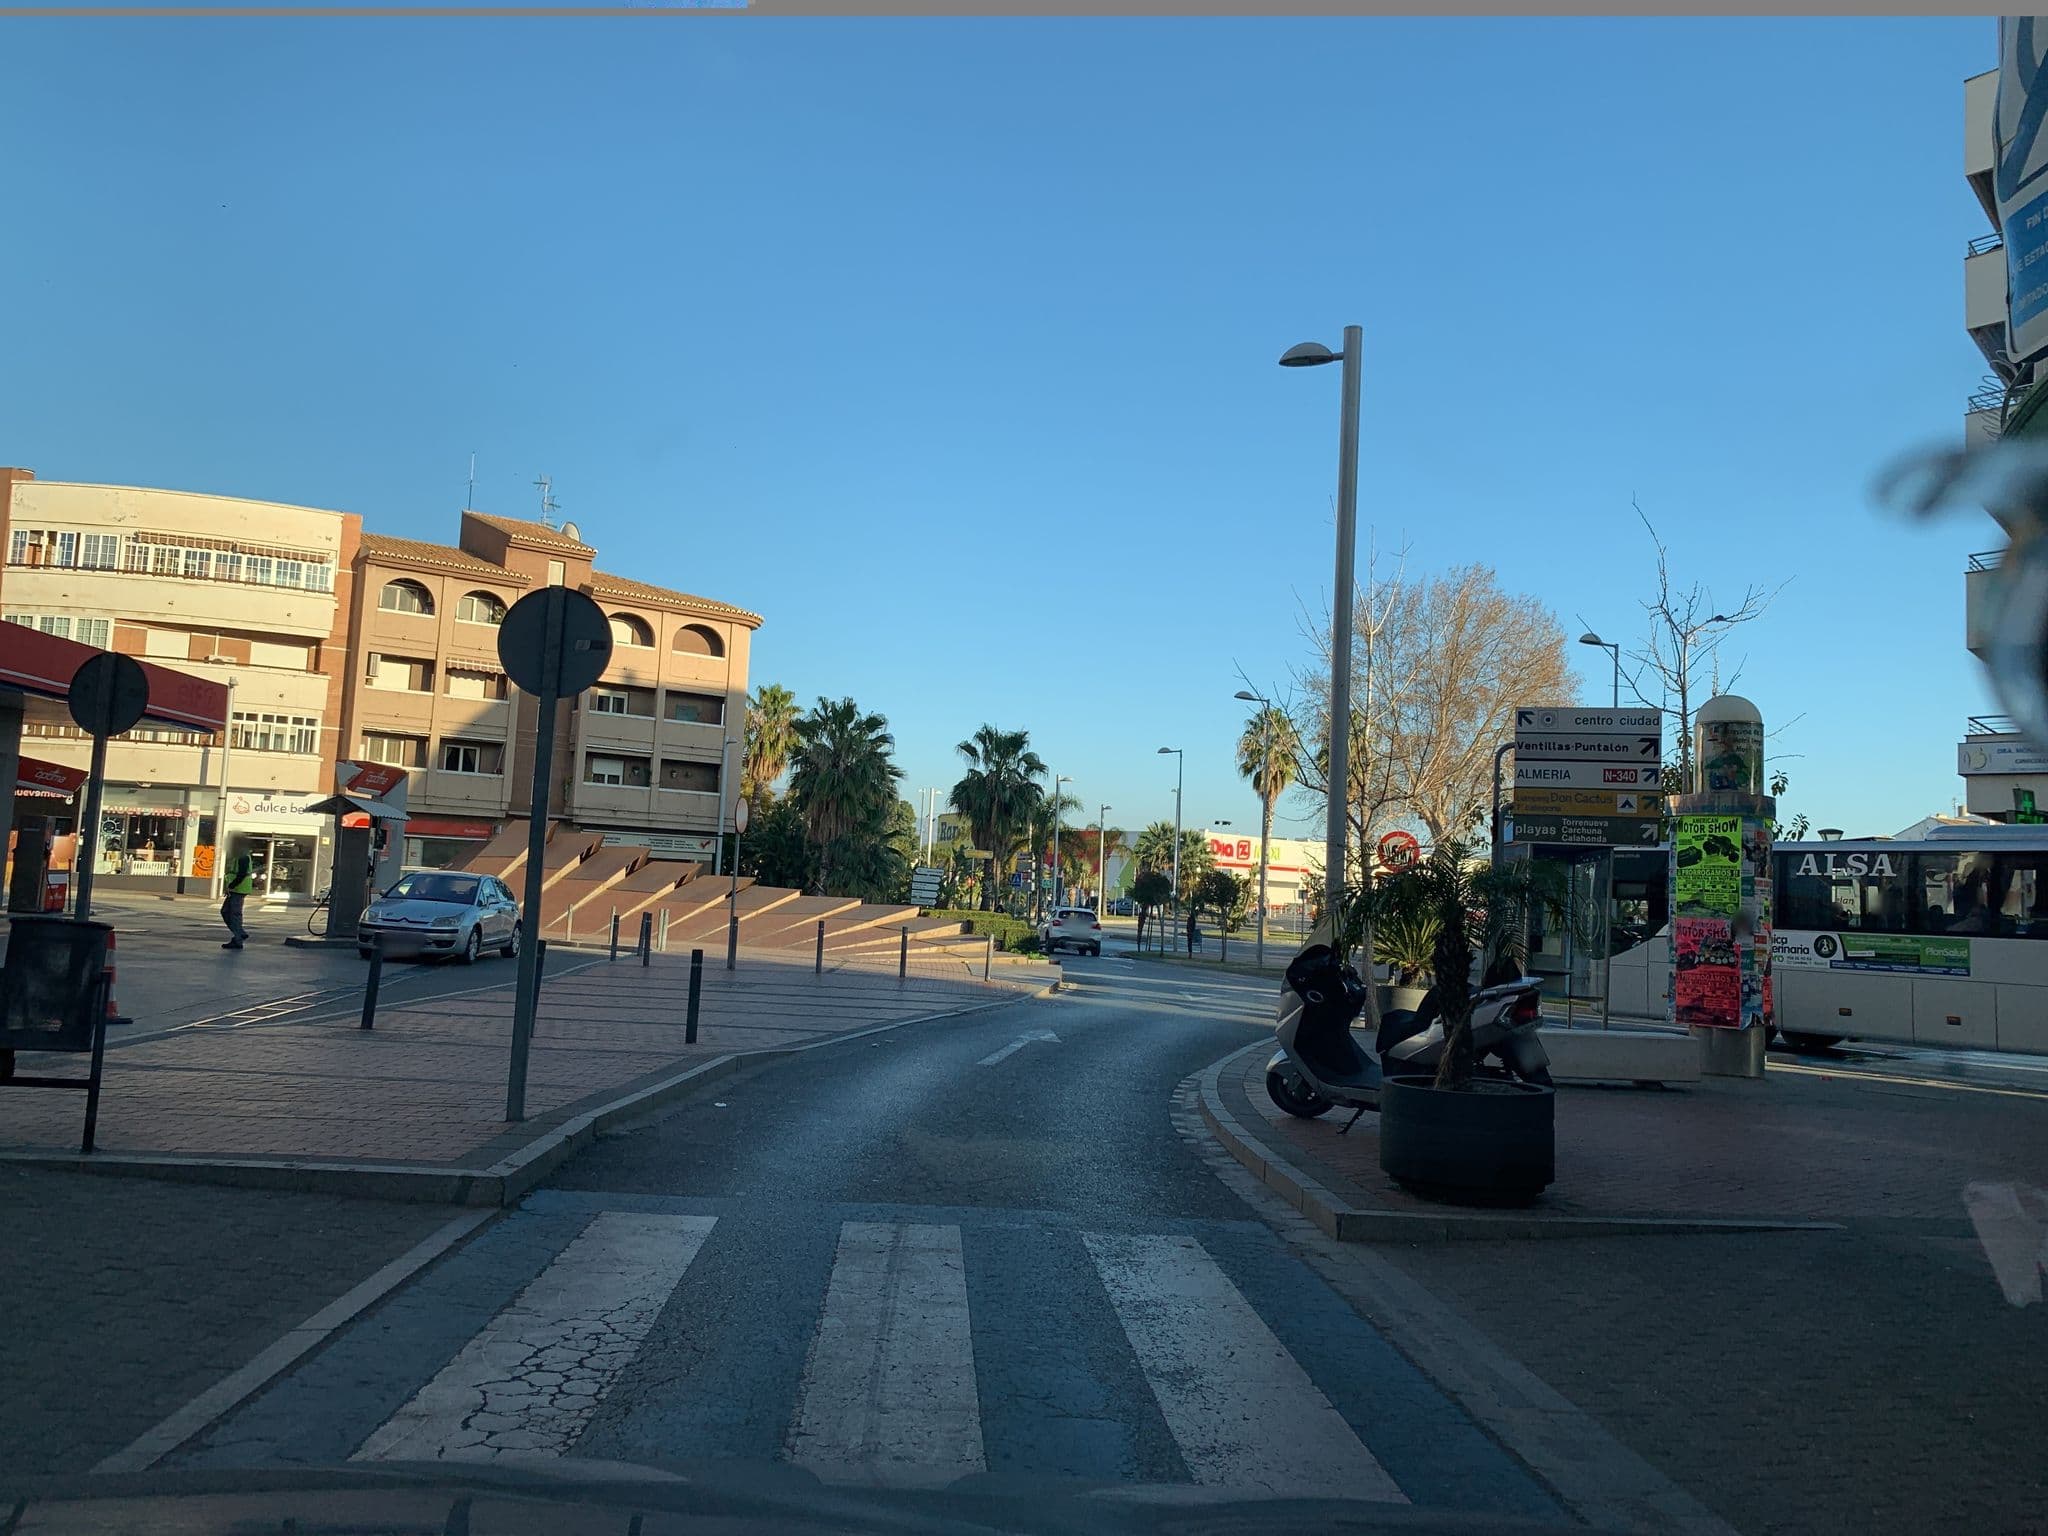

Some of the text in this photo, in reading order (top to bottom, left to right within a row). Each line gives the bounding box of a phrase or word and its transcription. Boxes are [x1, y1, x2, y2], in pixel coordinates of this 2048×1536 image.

[1575, 715, 1660, 726] centro ciudad
[1604, 770, 1636, 782] N-340
[254, 802, 287, 814] dulce
[1515, 818, 1609, 837] playas Torrenueva
[1561, 826, 1603, 835] Carchuna
[1678, 818, 1739, 834] MOTOR SHOW
[1561, 834, 1607, 843] Calahonda
[1796, 853, 1897, 877] ALSA
